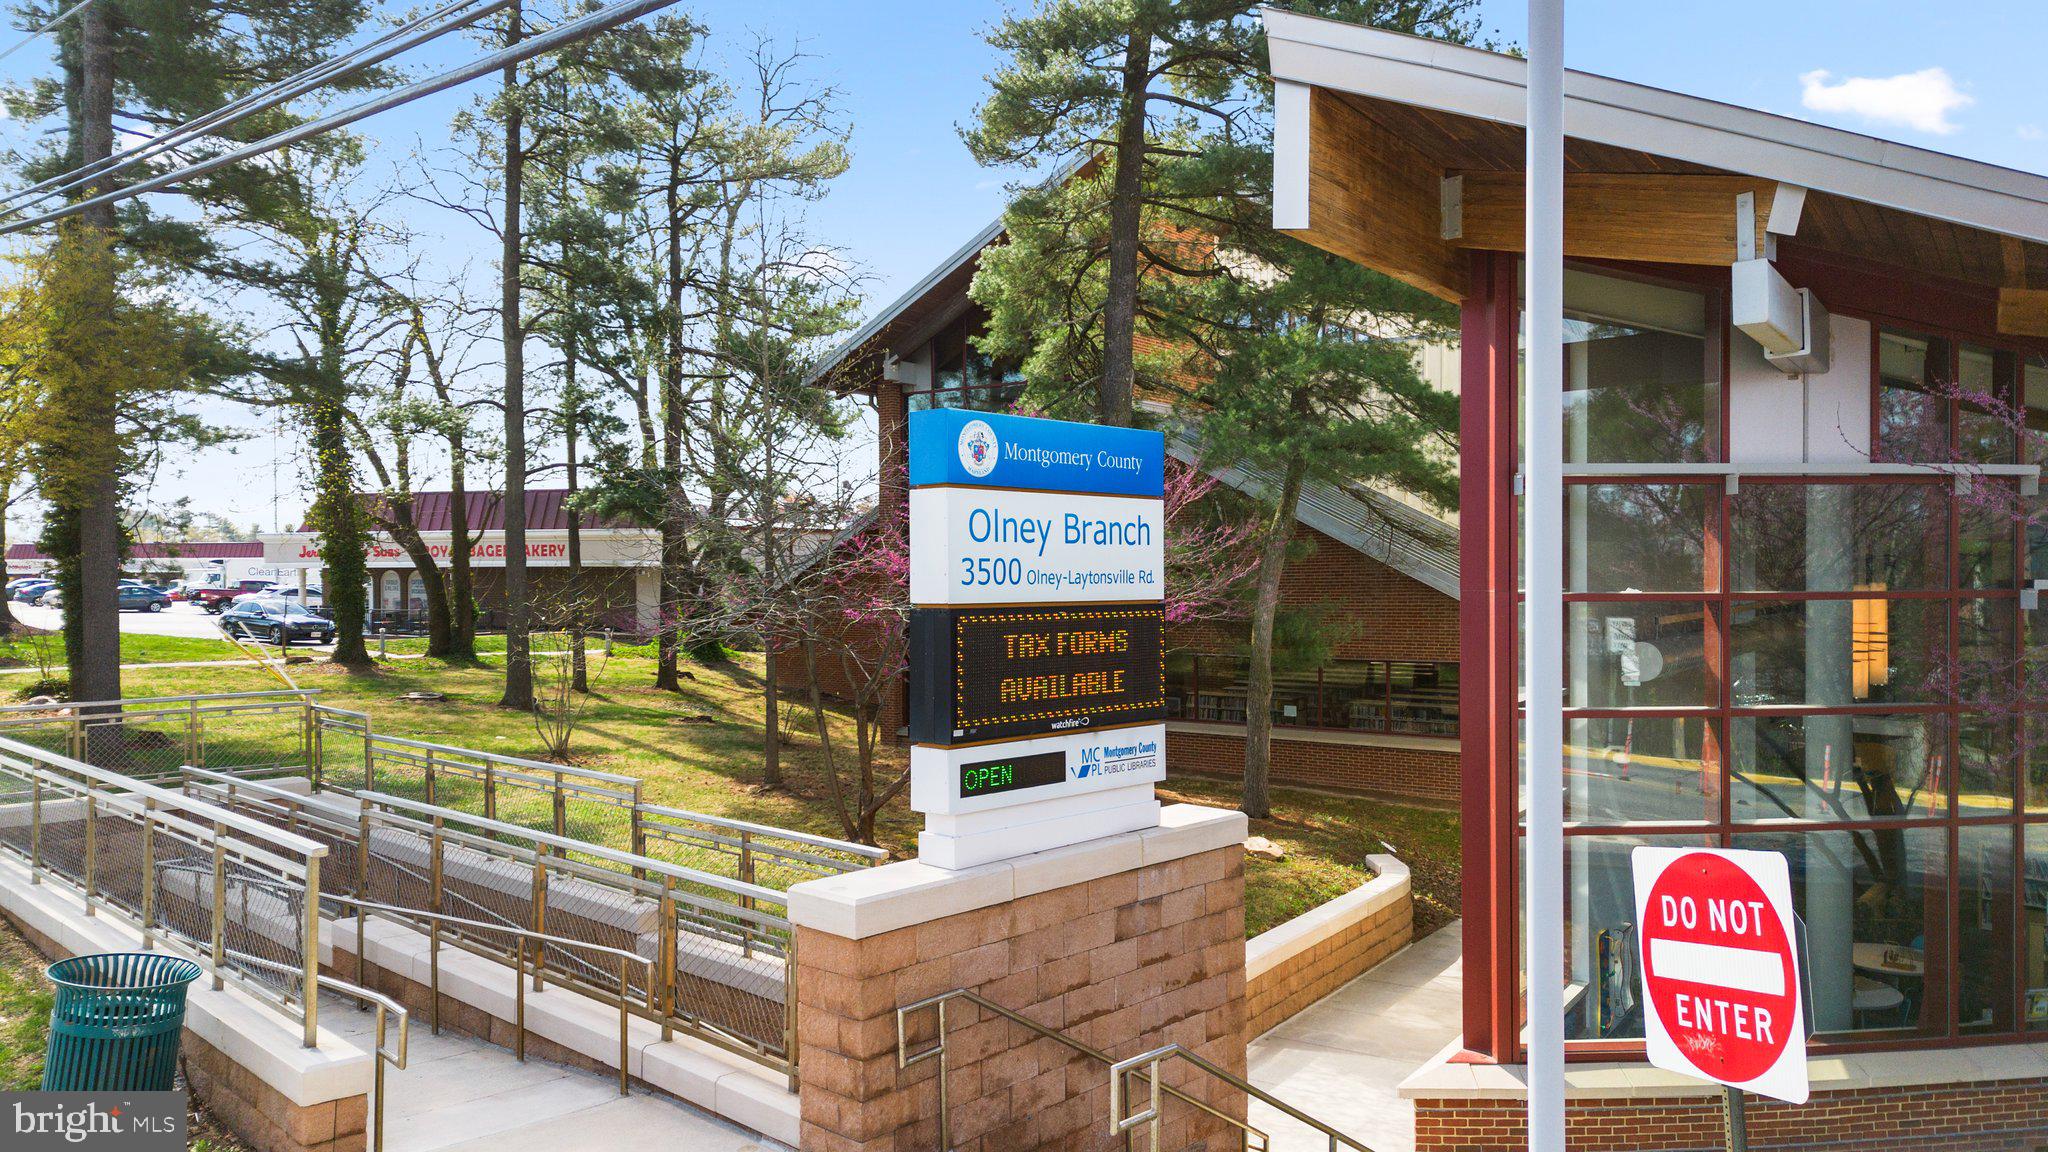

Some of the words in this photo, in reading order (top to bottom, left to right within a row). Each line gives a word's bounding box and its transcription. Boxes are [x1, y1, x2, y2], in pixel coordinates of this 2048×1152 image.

[1004, 442, 1092, 471] Montgomery
[1097, 450, 1143, 475] County
[969, 508, 1052, 557] Olney
[1064, 512, 1150, 546] Branch
[961, 557, 1022, 586] 3500
[1027, 569, 1135, 590] Olney-Laytonsville
[1138, 569, 1155, 584] Rd.
[1003, 633, 1050, 659] TAX
[1057, 630, 1129, 655] FORMS
[1001, 670, 1126, 703] AVAILABLE
[1051, 718, 1079, 730] watchfire
[1081, 747, 1100, 764] MC
[1103, 745, 1137, 759] Montgomery
[1138, 741, 1157, 754] County
[965, 764, 1013, 791] OPEN
[1091, 763, 1102, 777] PL
[1104, 763, 1126, 775] PUBLIC
[1127, 758, 1157, 771] LIBRARIES
[1661, 895, 1697, 930] DO
[1708, 898, 1764, 937] NOT
[1675, 993, 1775, 1045] ENTER
